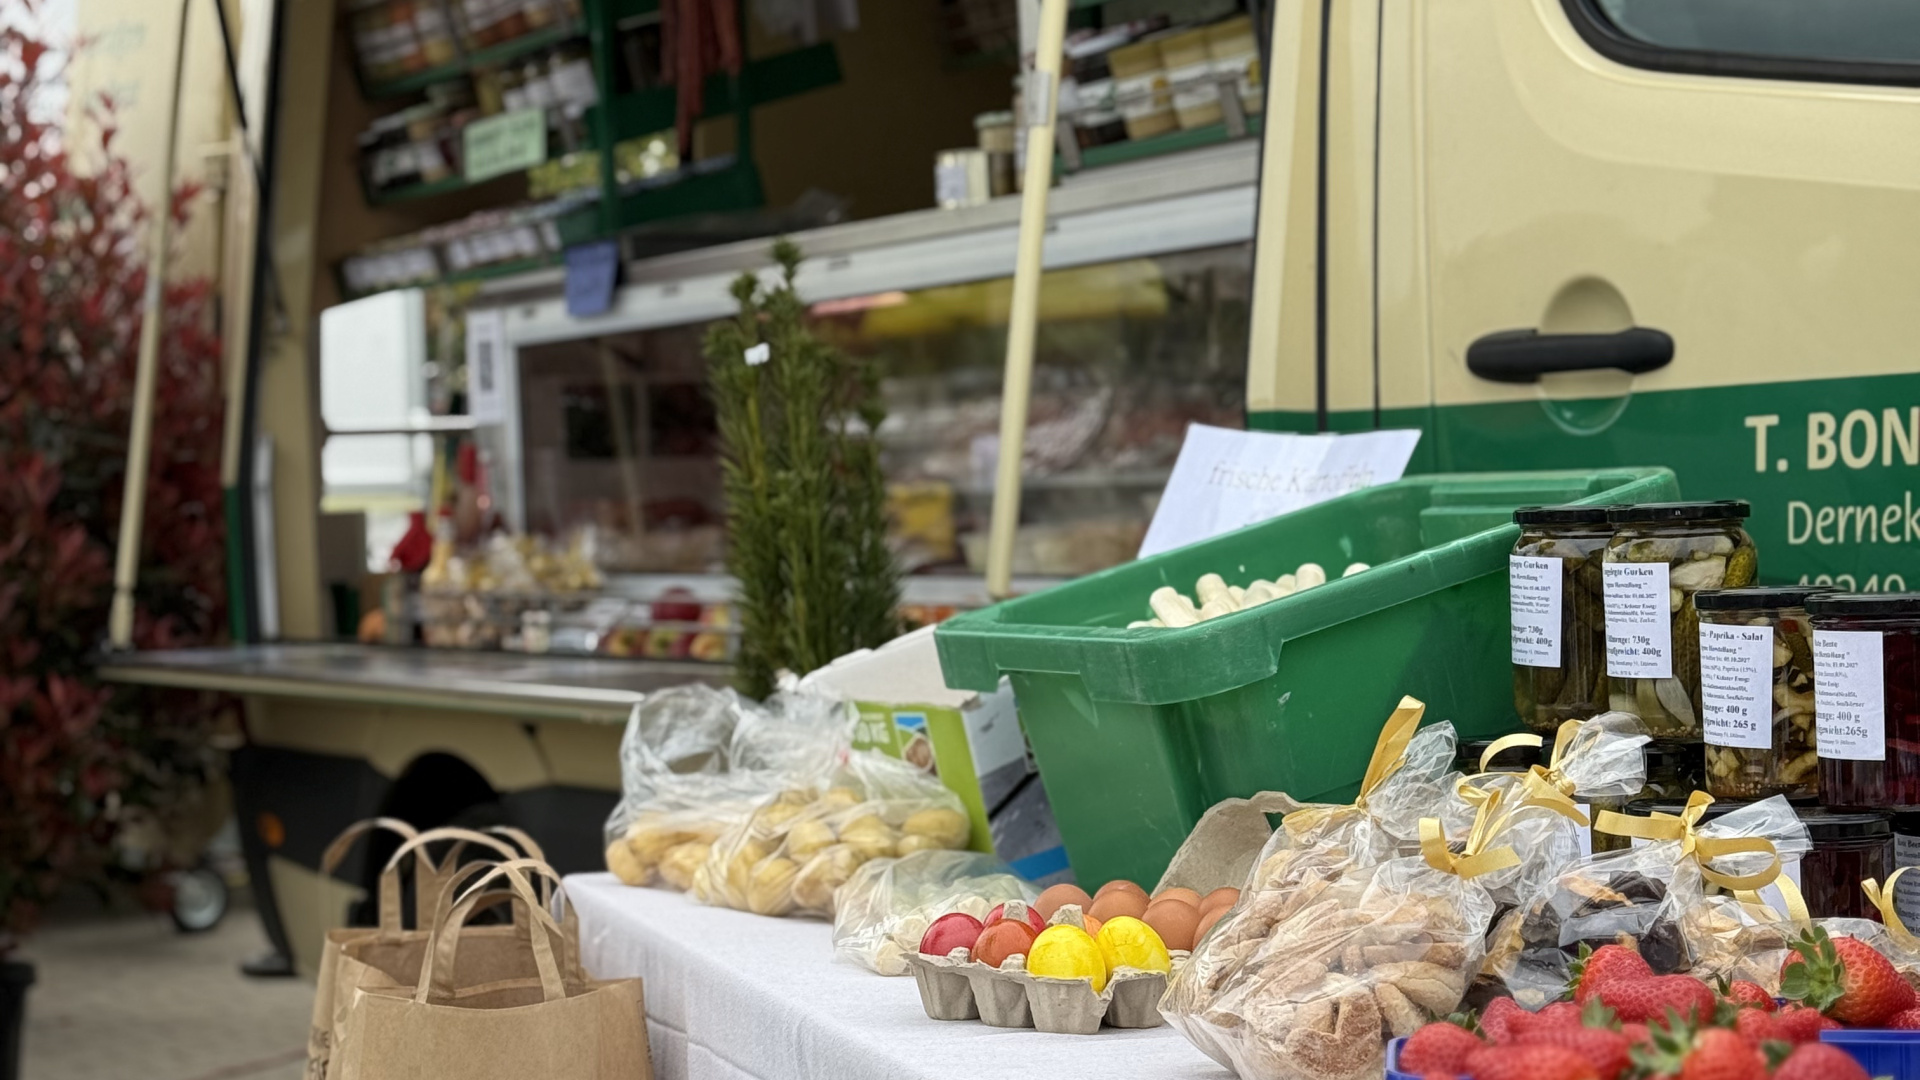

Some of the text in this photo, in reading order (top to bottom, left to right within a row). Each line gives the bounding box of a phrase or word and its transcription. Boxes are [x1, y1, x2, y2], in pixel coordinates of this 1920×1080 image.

[1744, 406, 1920, 473] T. BON
[1788, 490, 1920, 544] Dernek
[1624, 568, 1654, 576] Gurken
[1632, 635, 1650, 646] 730g
[1710, 630, 1734, 641] Paprika
[1742, 632, 1764, 641] Salat
[1642, 648, 1662, 657] 400g
[1726, 705, 1740, 714] 400
[1742, 708, 1748, 716] g
[1836, 712, 1852, 721] 400
[1854, 714, 1860, 723] g
[1733, 720, 1748, 728] 265
[1750, 723, 1756, 731] g
